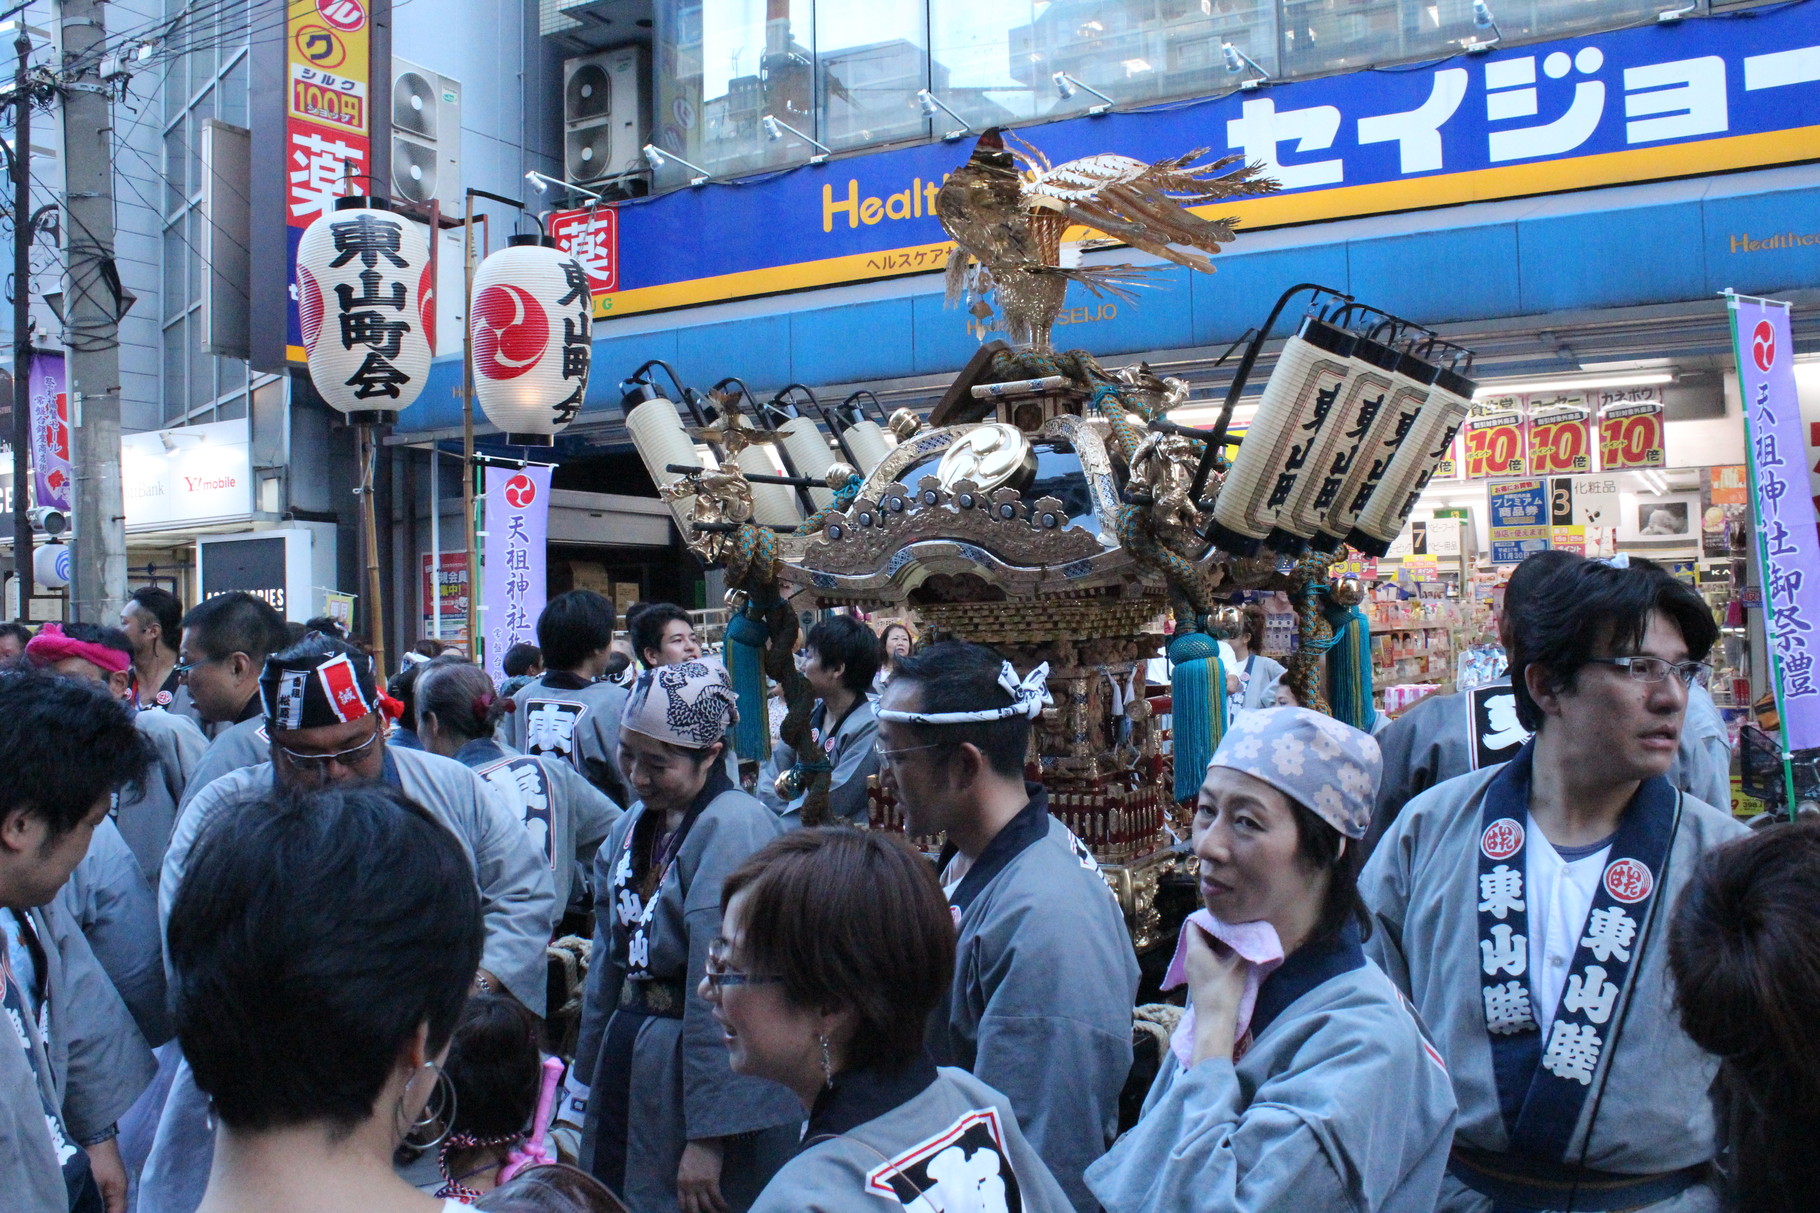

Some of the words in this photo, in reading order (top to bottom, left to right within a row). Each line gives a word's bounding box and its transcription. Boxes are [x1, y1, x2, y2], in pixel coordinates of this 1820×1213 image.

[306, 33, 334, 61] ク
[301, 67, 356, 91] シルク
[296, 82, 360, 127] 100円
[289, 133, 365, 218] 薬
[823, 172, 950, 232] Healt
[558, 218, 611, 282] 薬
[328, 213, 411, 401] 東山町会
[1056, 303, 1117, 326] SEIJO
[1602, 386, 1653, 406] カネボウ
[1469, 427, 1518, 475] 10
[1531, 422, 1583, 471] 10
[1602, 415, 1655, 467] 10
[1492, 497, 1543, 508] プレミアム
[1553, 488, 1571, 516] 3
[1574, 480, 1617, 495] 化粧品
[1413, 529, 1426, 548] 7
